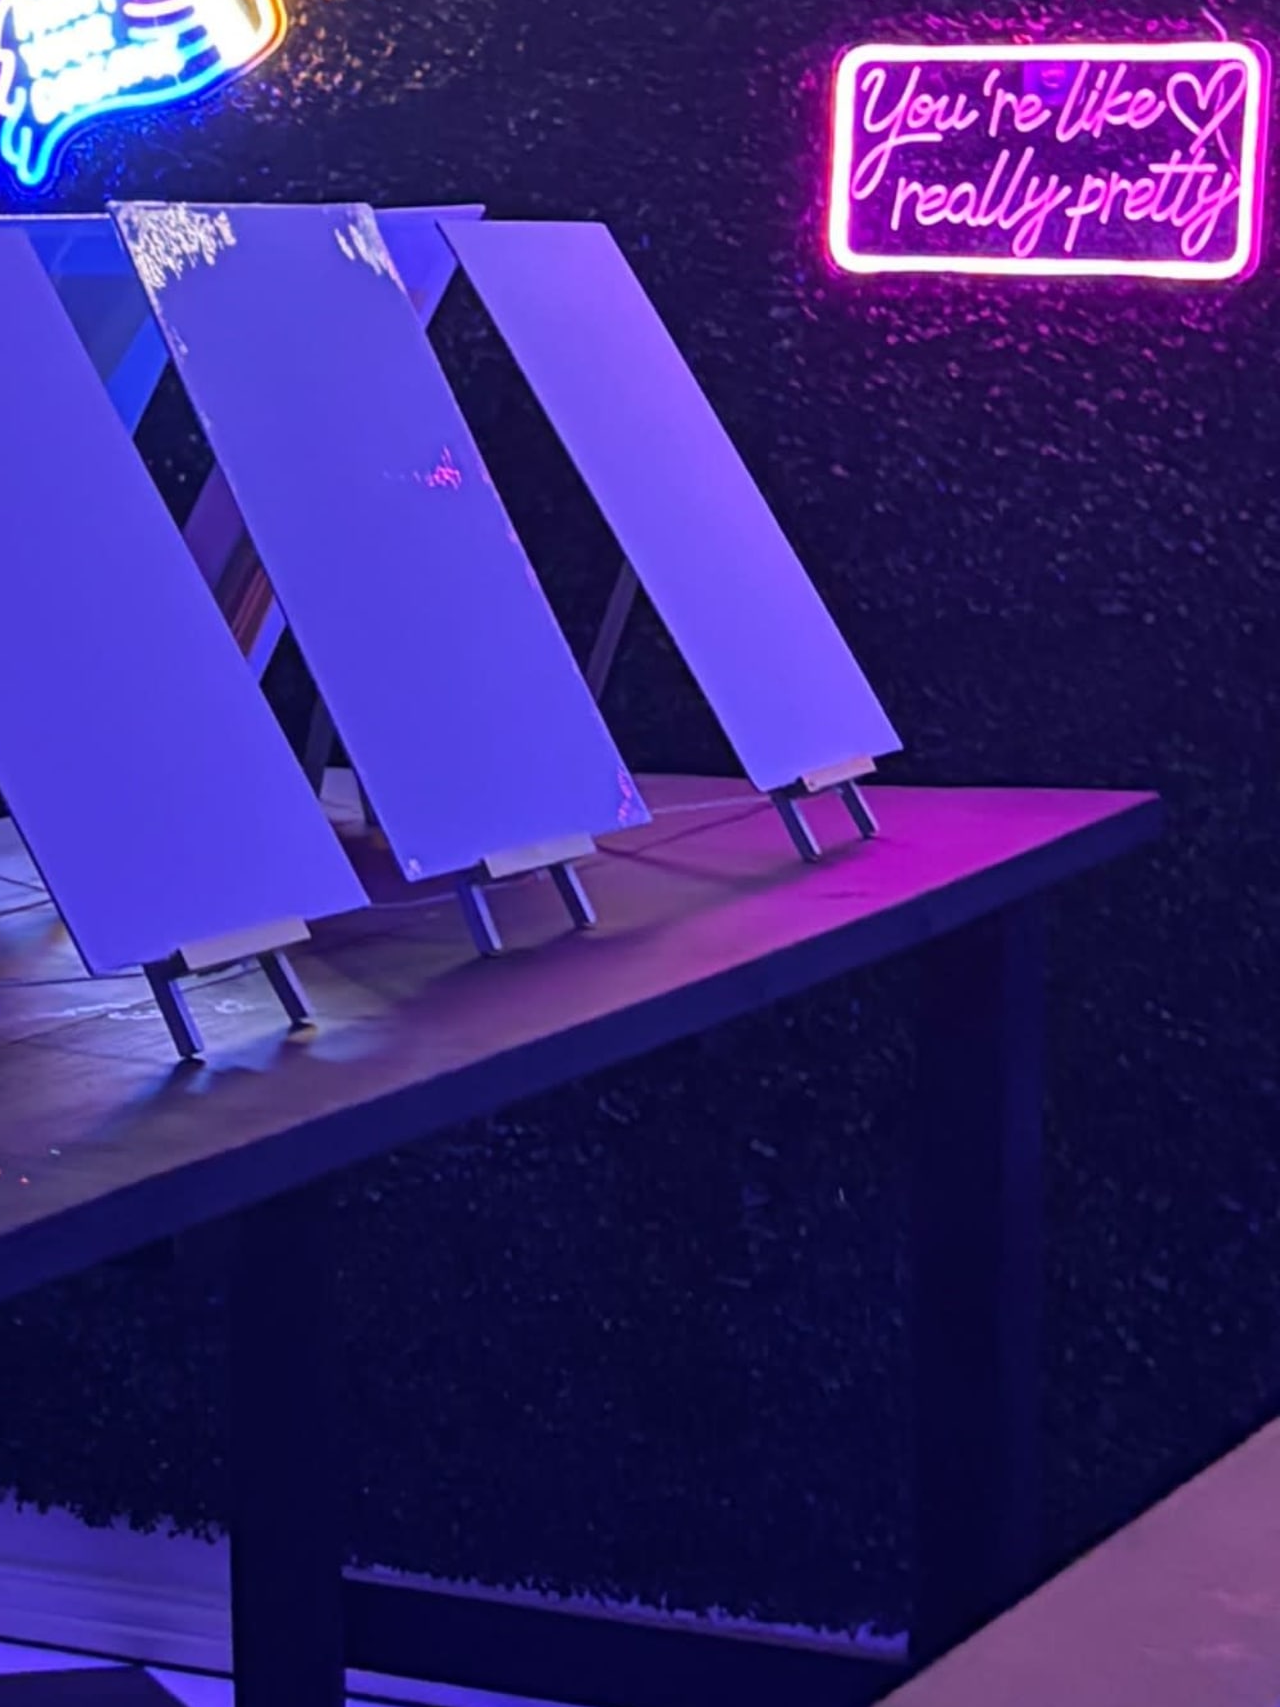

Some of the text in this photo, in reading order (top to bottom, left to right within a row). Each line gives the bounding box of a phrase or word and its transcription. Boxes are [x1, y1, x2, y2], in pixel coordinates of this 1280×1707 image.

[851, 60, 1167, 200] You're like
[889, 146, 1240, 257] really pretty
